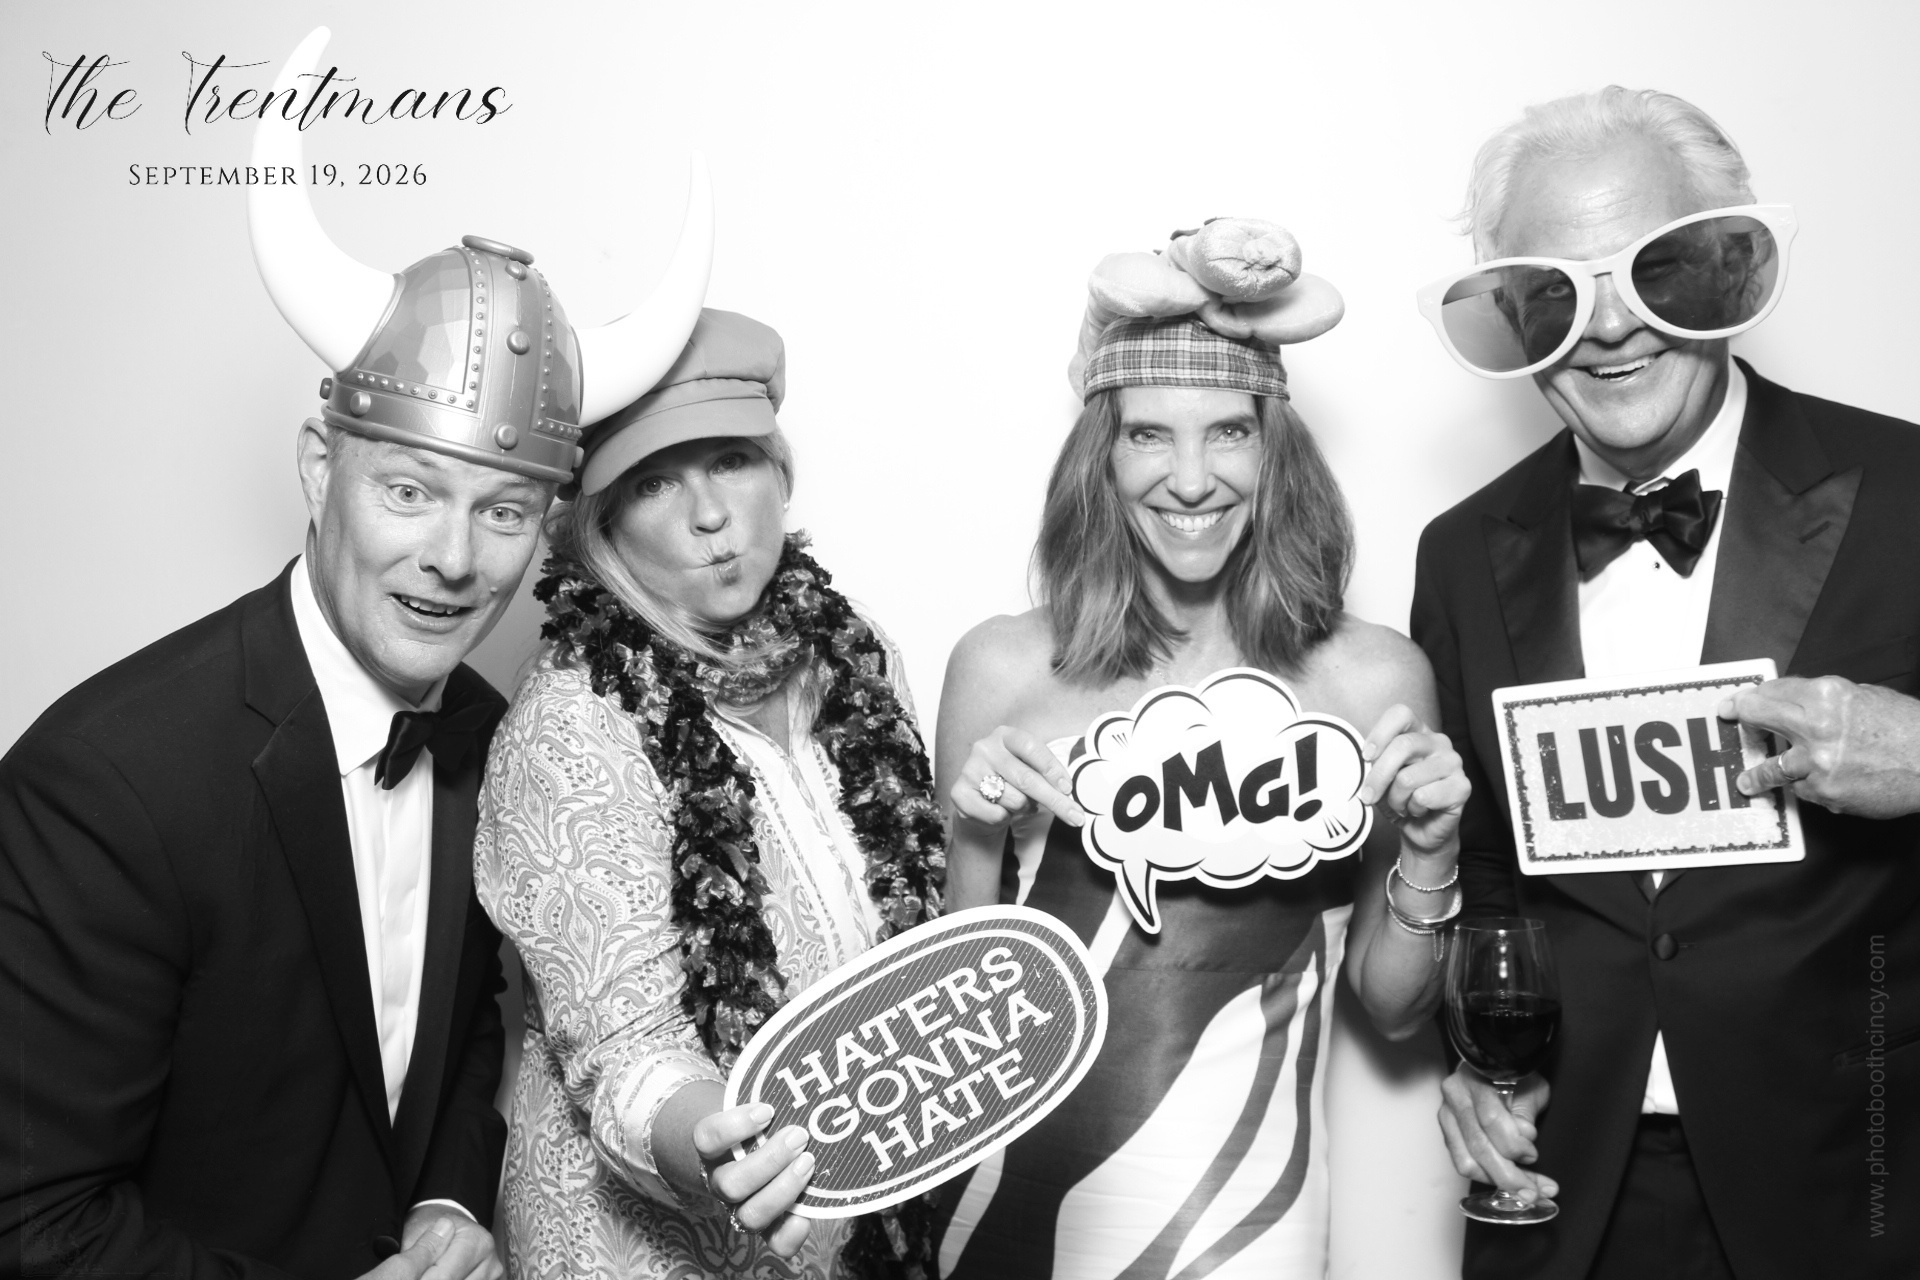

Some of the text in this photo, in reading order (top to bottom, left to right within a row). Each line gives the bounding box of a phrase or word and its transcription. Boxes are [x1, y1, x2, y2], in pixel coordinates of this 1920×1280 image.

[1112, 731, 1323, 833] OMG!
[1537, 715, 1751, 822] LUSH
[776, 946, 1023, 1109] HATERS
[808, 989, 1053, 1143] GONNA
[861, 1048, 1036, 1172] HATE
